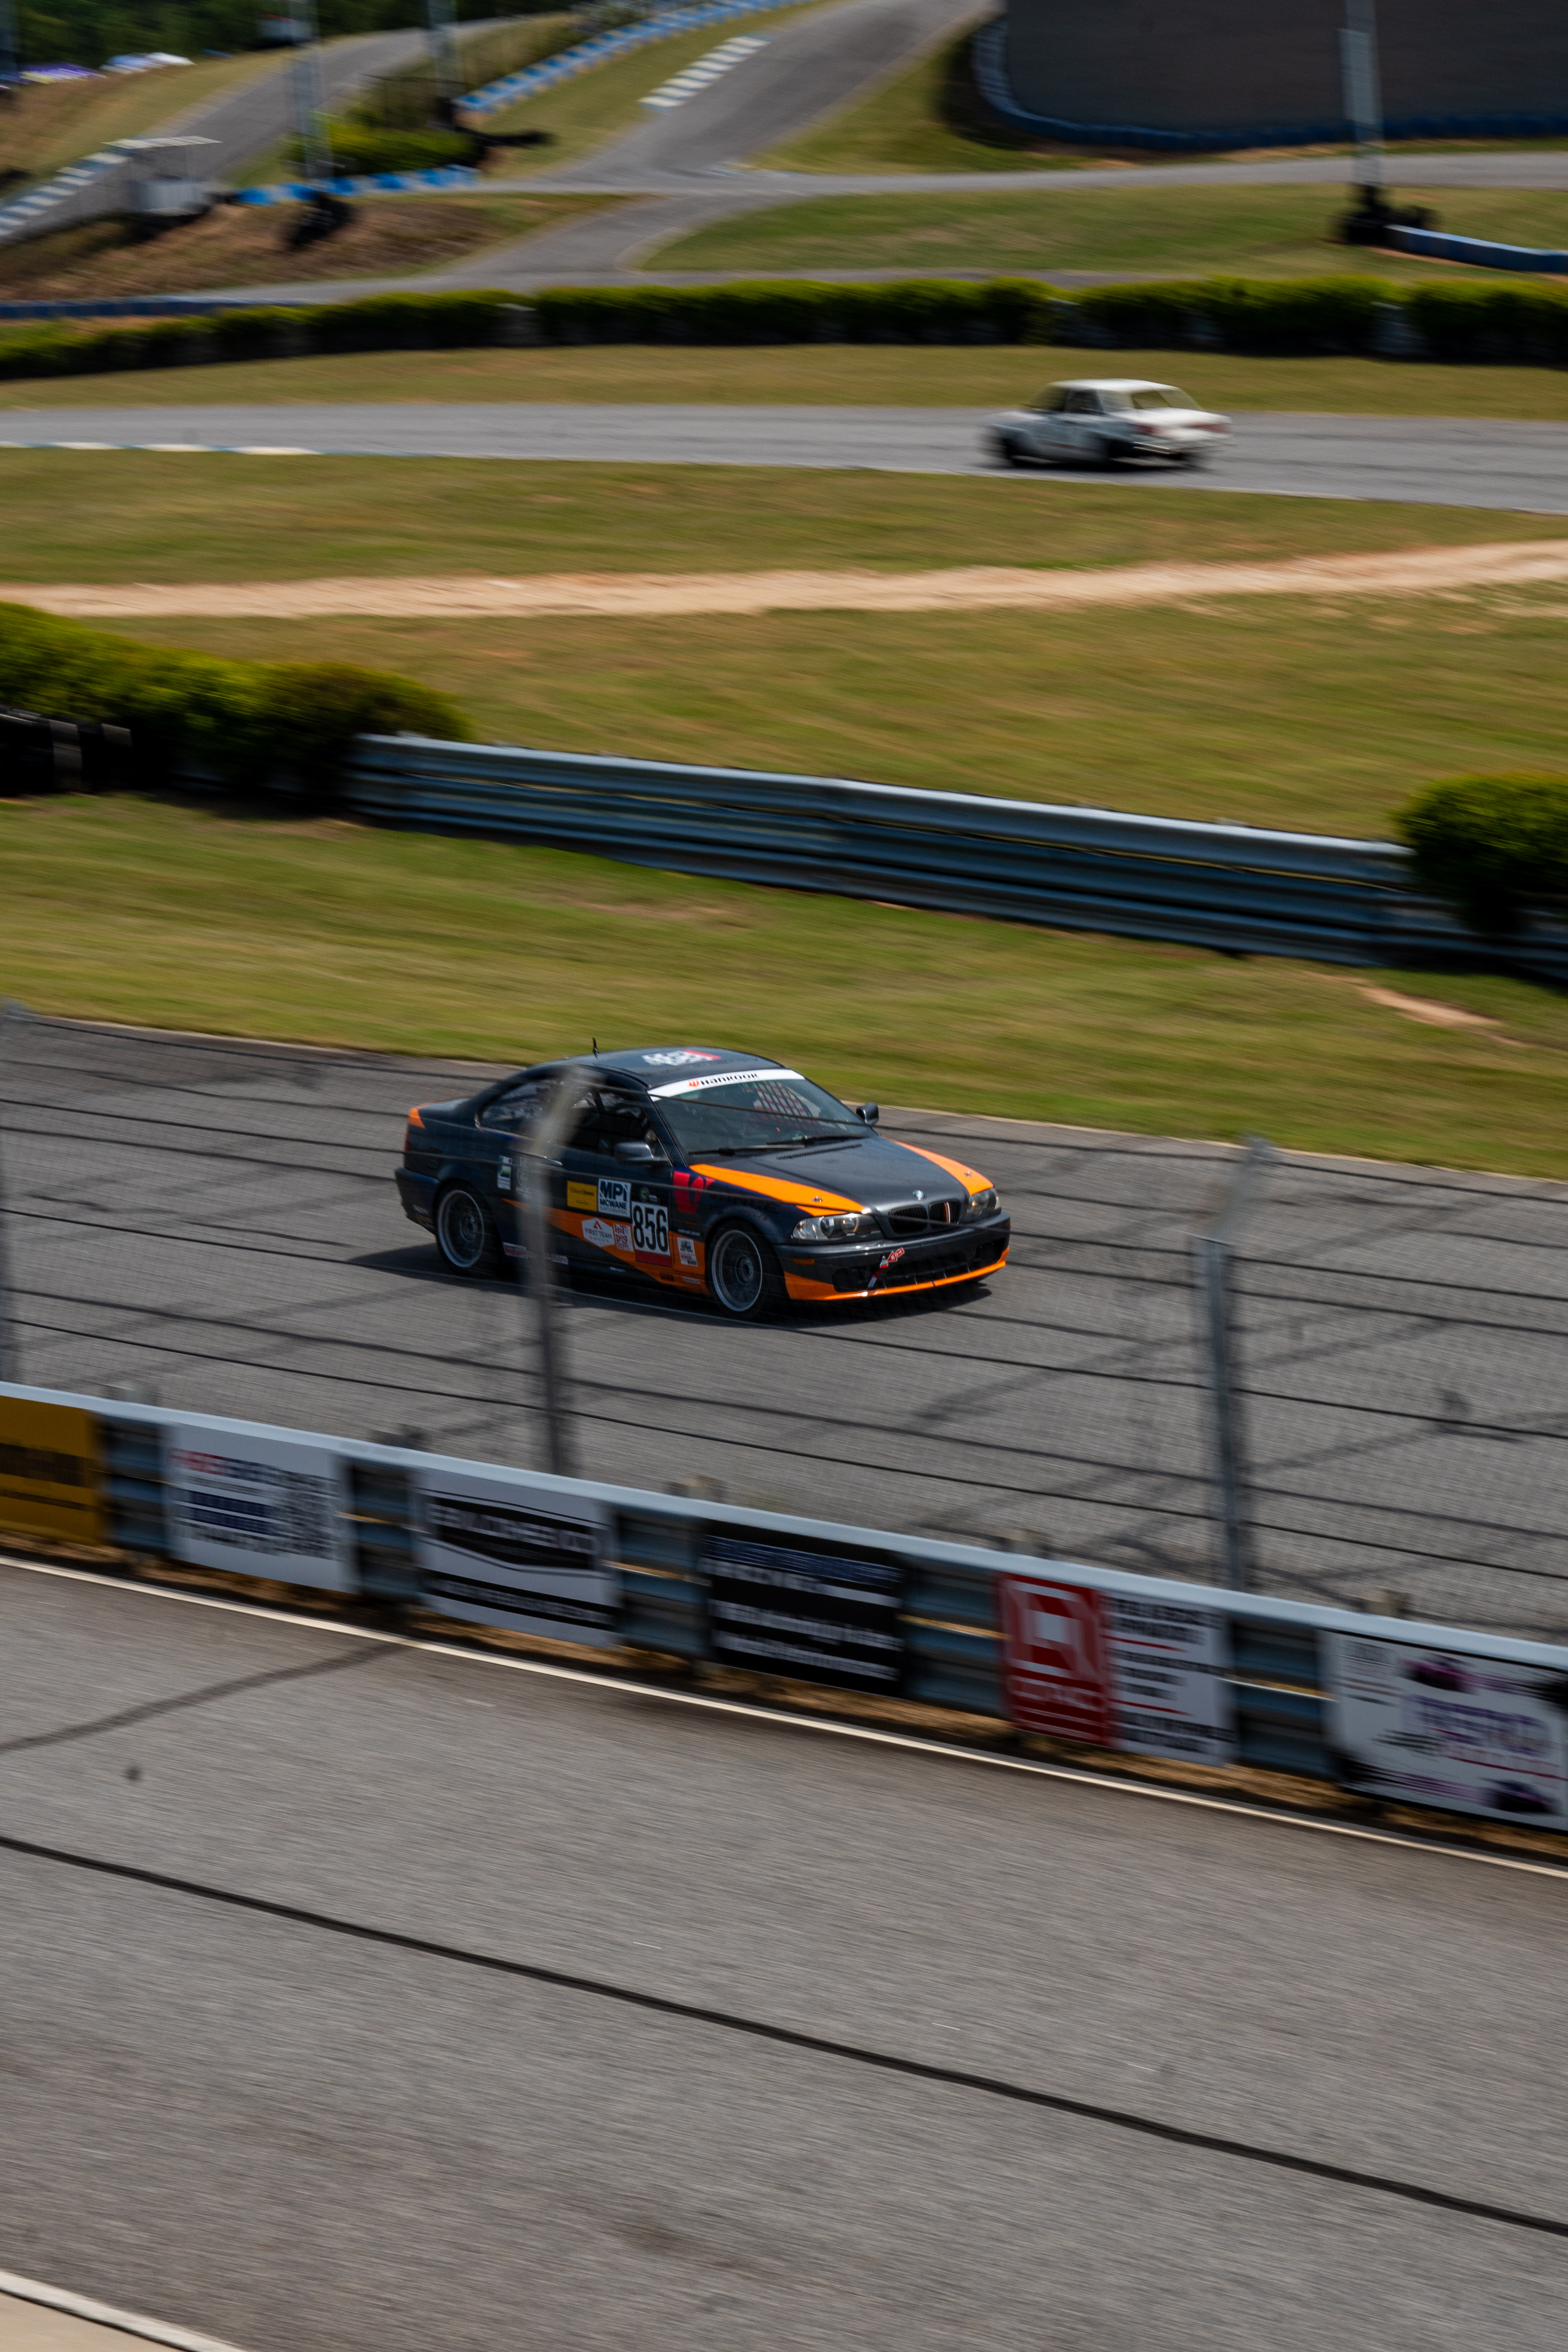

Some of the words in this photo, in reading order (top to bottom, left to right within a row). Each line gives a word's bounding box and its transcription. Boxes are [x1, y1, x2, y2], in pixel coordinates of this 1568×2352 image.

[584, 1228, 598, 1236] FIRST
[599, 1230, 612, 1239] TEAM
[632, 1205, 668, 1252] 856
